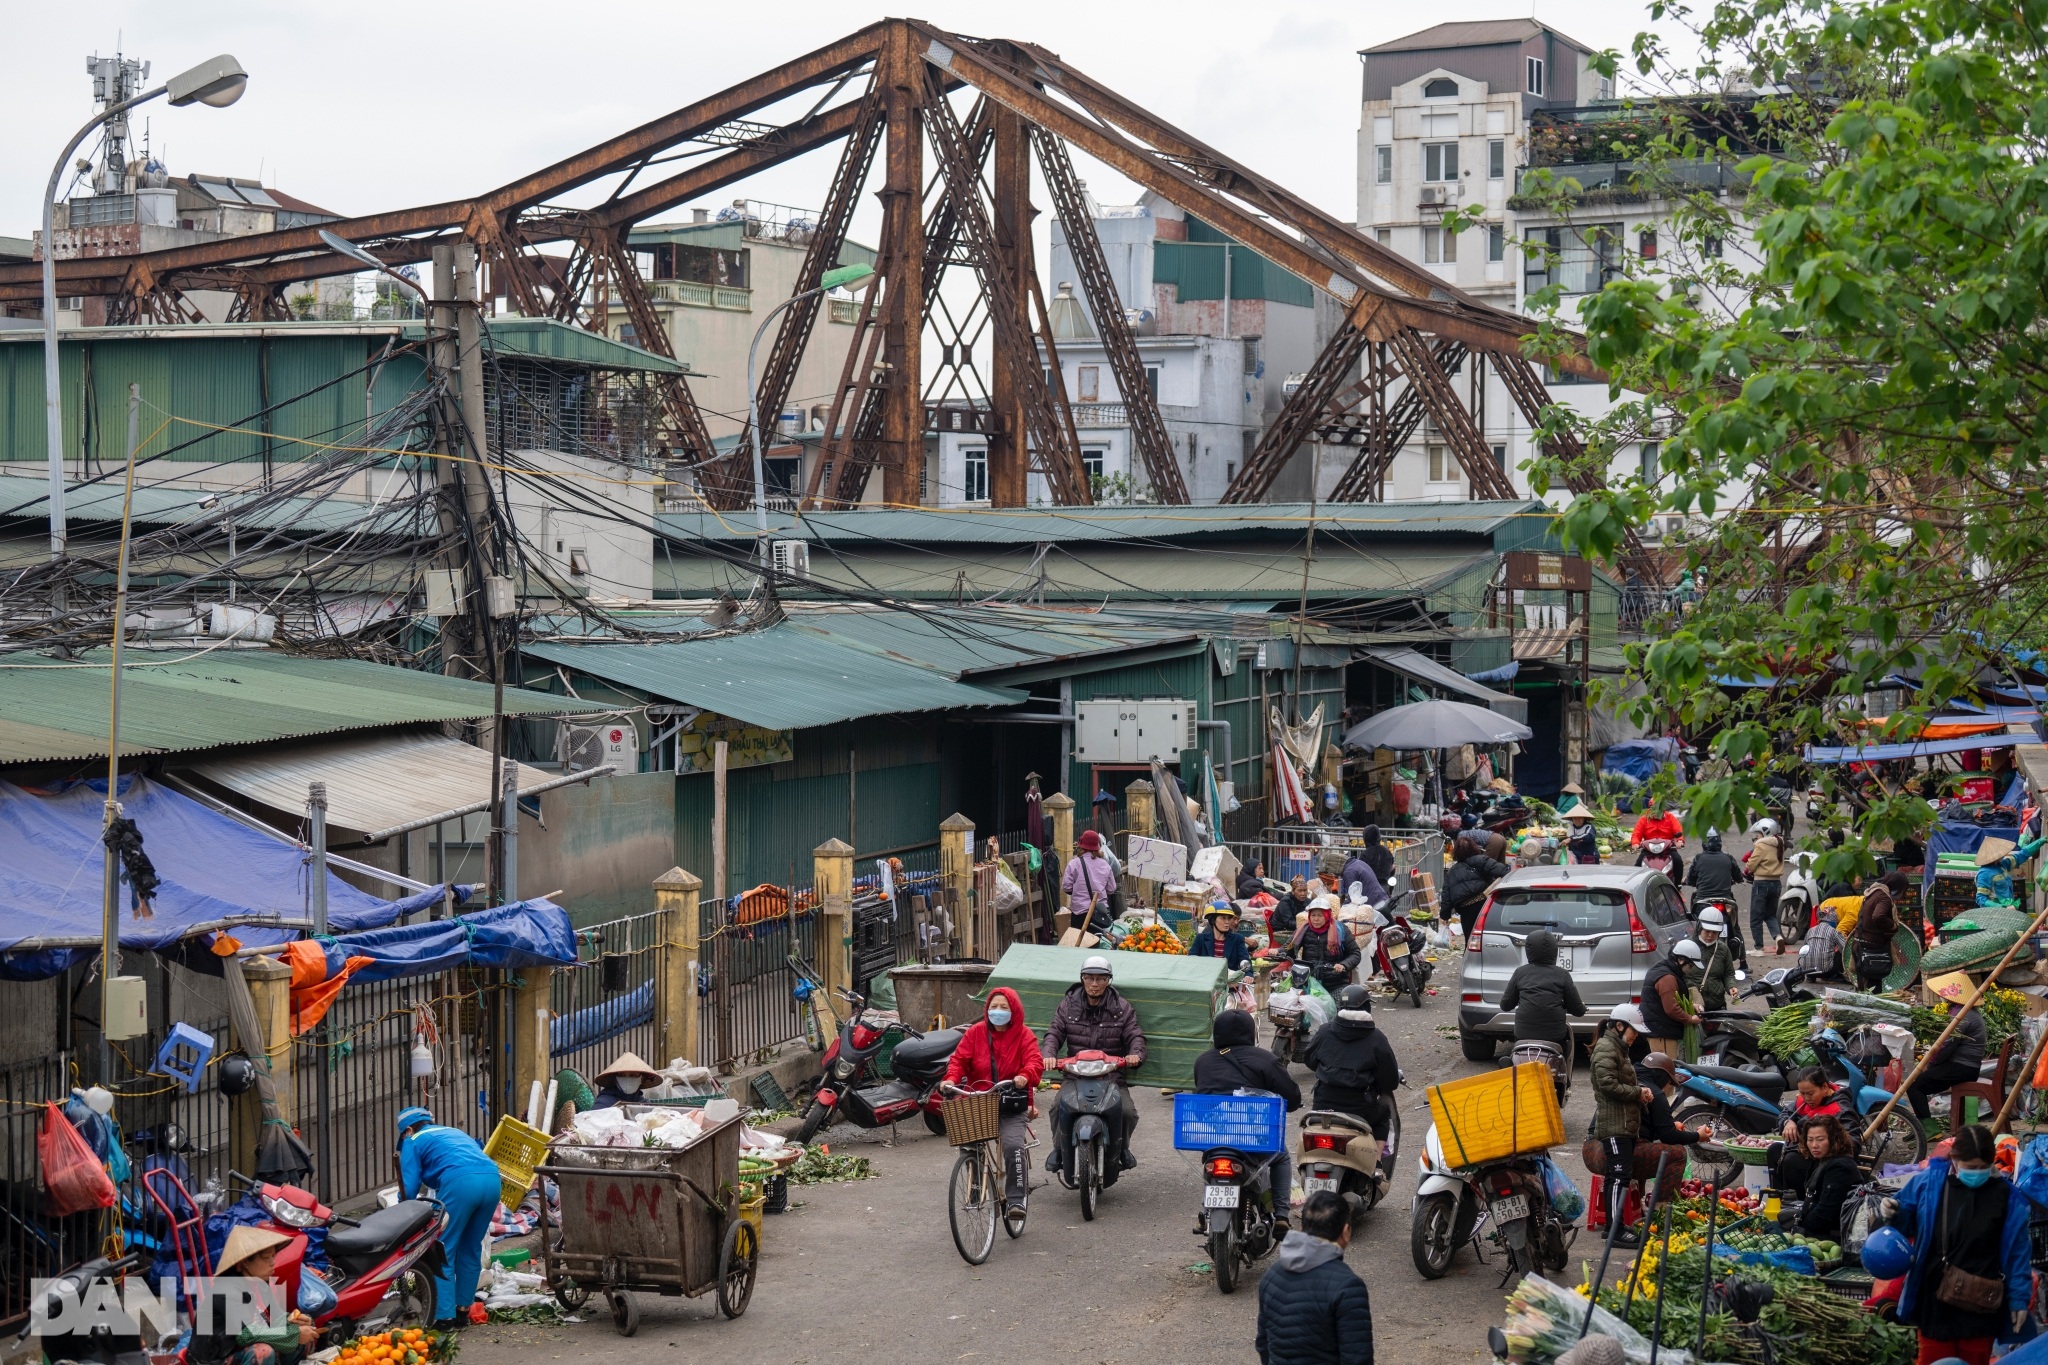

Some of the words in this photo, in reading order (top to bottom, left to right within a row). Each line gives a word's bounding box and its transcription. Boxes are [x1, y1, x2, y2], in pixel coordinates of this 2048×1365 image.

[1129, 836, 1154, 862] 25
[1171, 844, 1181, 866] K
[1309, 1180, 1332, 1191] 30-M4
[1209, 1187, 1235, 1196] 29-BG
[1206, 1197, 1237, 1207] 082.67
[1496, 1196, 1521, 1211] 29-B1
